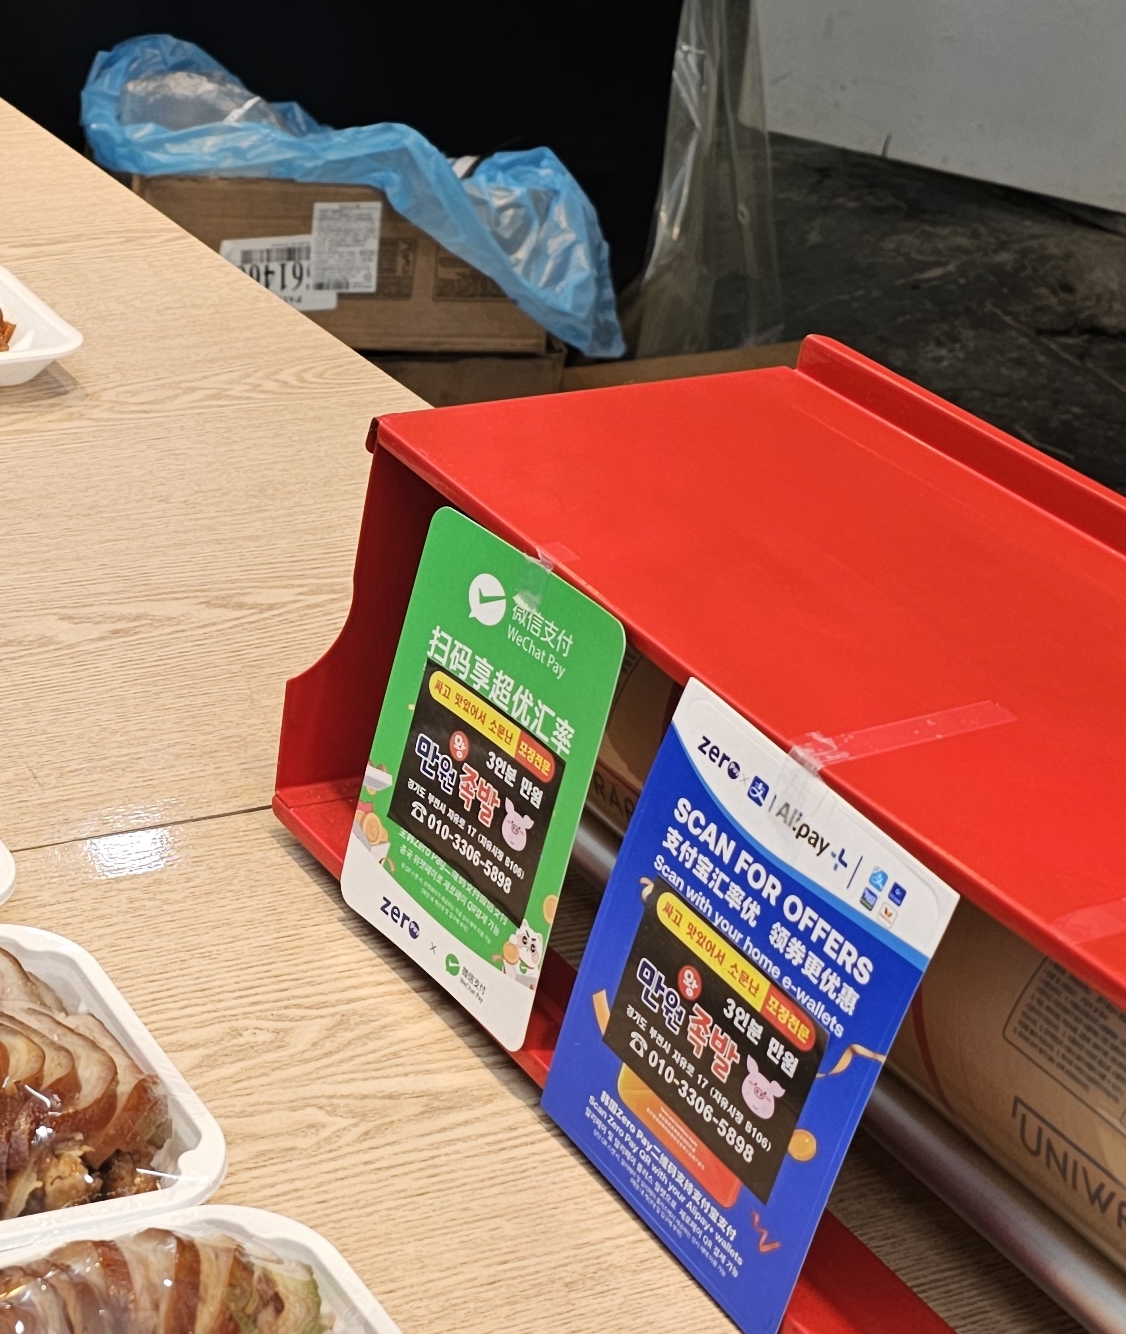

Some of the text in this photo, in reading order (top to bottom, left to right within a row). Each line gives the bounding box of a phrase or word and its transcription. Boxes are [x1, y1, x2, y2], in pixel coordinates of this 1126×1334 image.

[427, 625, 575, 755] 扫码享超优汇率
[507, 624, 566, 680] WeChat Pay
[486, 751, 543, 809] 3인분 만원
[428, 814, 512, 894] 010-3306-5898
[674, 798, 873, 984] SCAN FOR OFFERS
[654, 855, 844, 1038] Scan with your home e-wallets
[662, 826, 860, 1016] 支付宝汇率优 领券更优惠
[686, 922, 726, 966] 맛있어서
[727, 963, 760, 997] 소문난
[723, 998, 799, 1078] 3인분 만원
[648, 1050, 754, 1163] 010-3306-5898
[697, 1074, 709, 1089] 17
[607, 1115, 624, 1137] Zero
[624, 1133, 639, 1153] Pay
[652, 1163, 668, 1185] with
[667, 1182, 686, 1203] your
